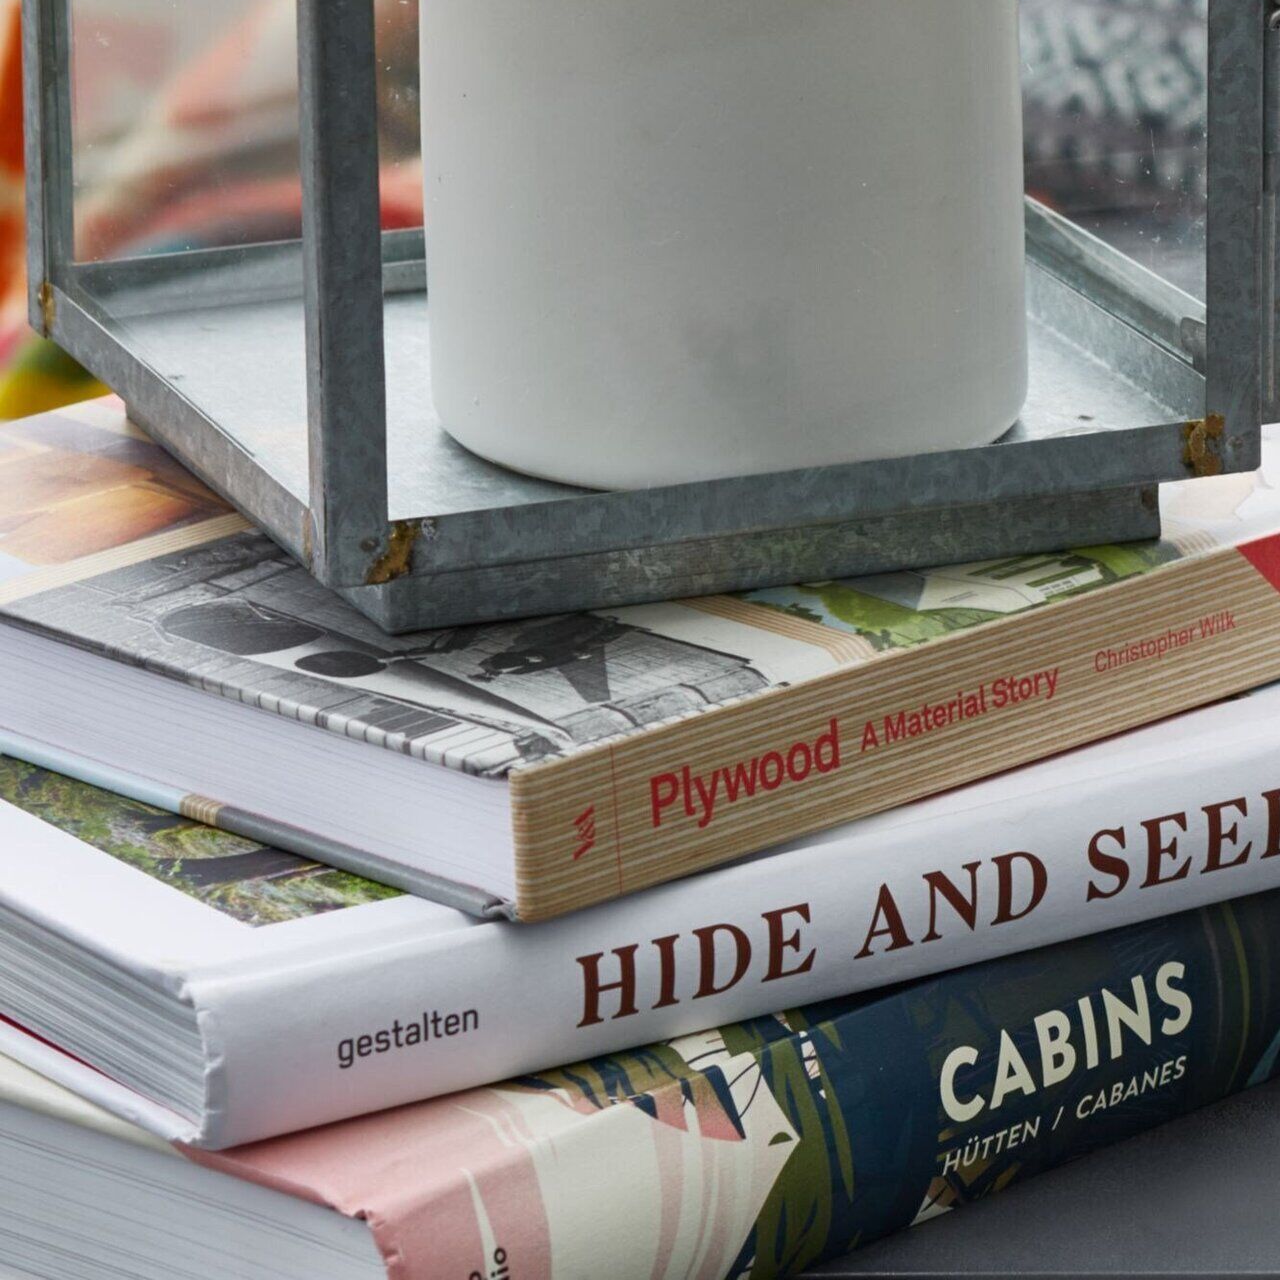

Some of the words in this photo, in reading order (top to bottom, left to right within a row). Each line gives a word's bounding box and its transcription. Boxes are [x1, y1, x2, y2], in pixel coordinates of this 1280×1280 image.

[1094, 626, 1197, 672] Christopher
[1199, 610, 1236, 638] Wilk
[650, 718, 841, 827] Plywood
[860, 721, 879, 752] A
[883, 690, 988, 742] Material
[992, 667, 1060, 710] Story
[576, 903, 816, 1027] HIDE
[853, 851, 1048, 959] AND
[338, 1009, 479, 1069] gestalten
[940, 961, 1192, 1122] CABINS
[942, 1116, 1040, 1176] HÜTTEN
[1076, 1055, 1187, 1119] CABANES
